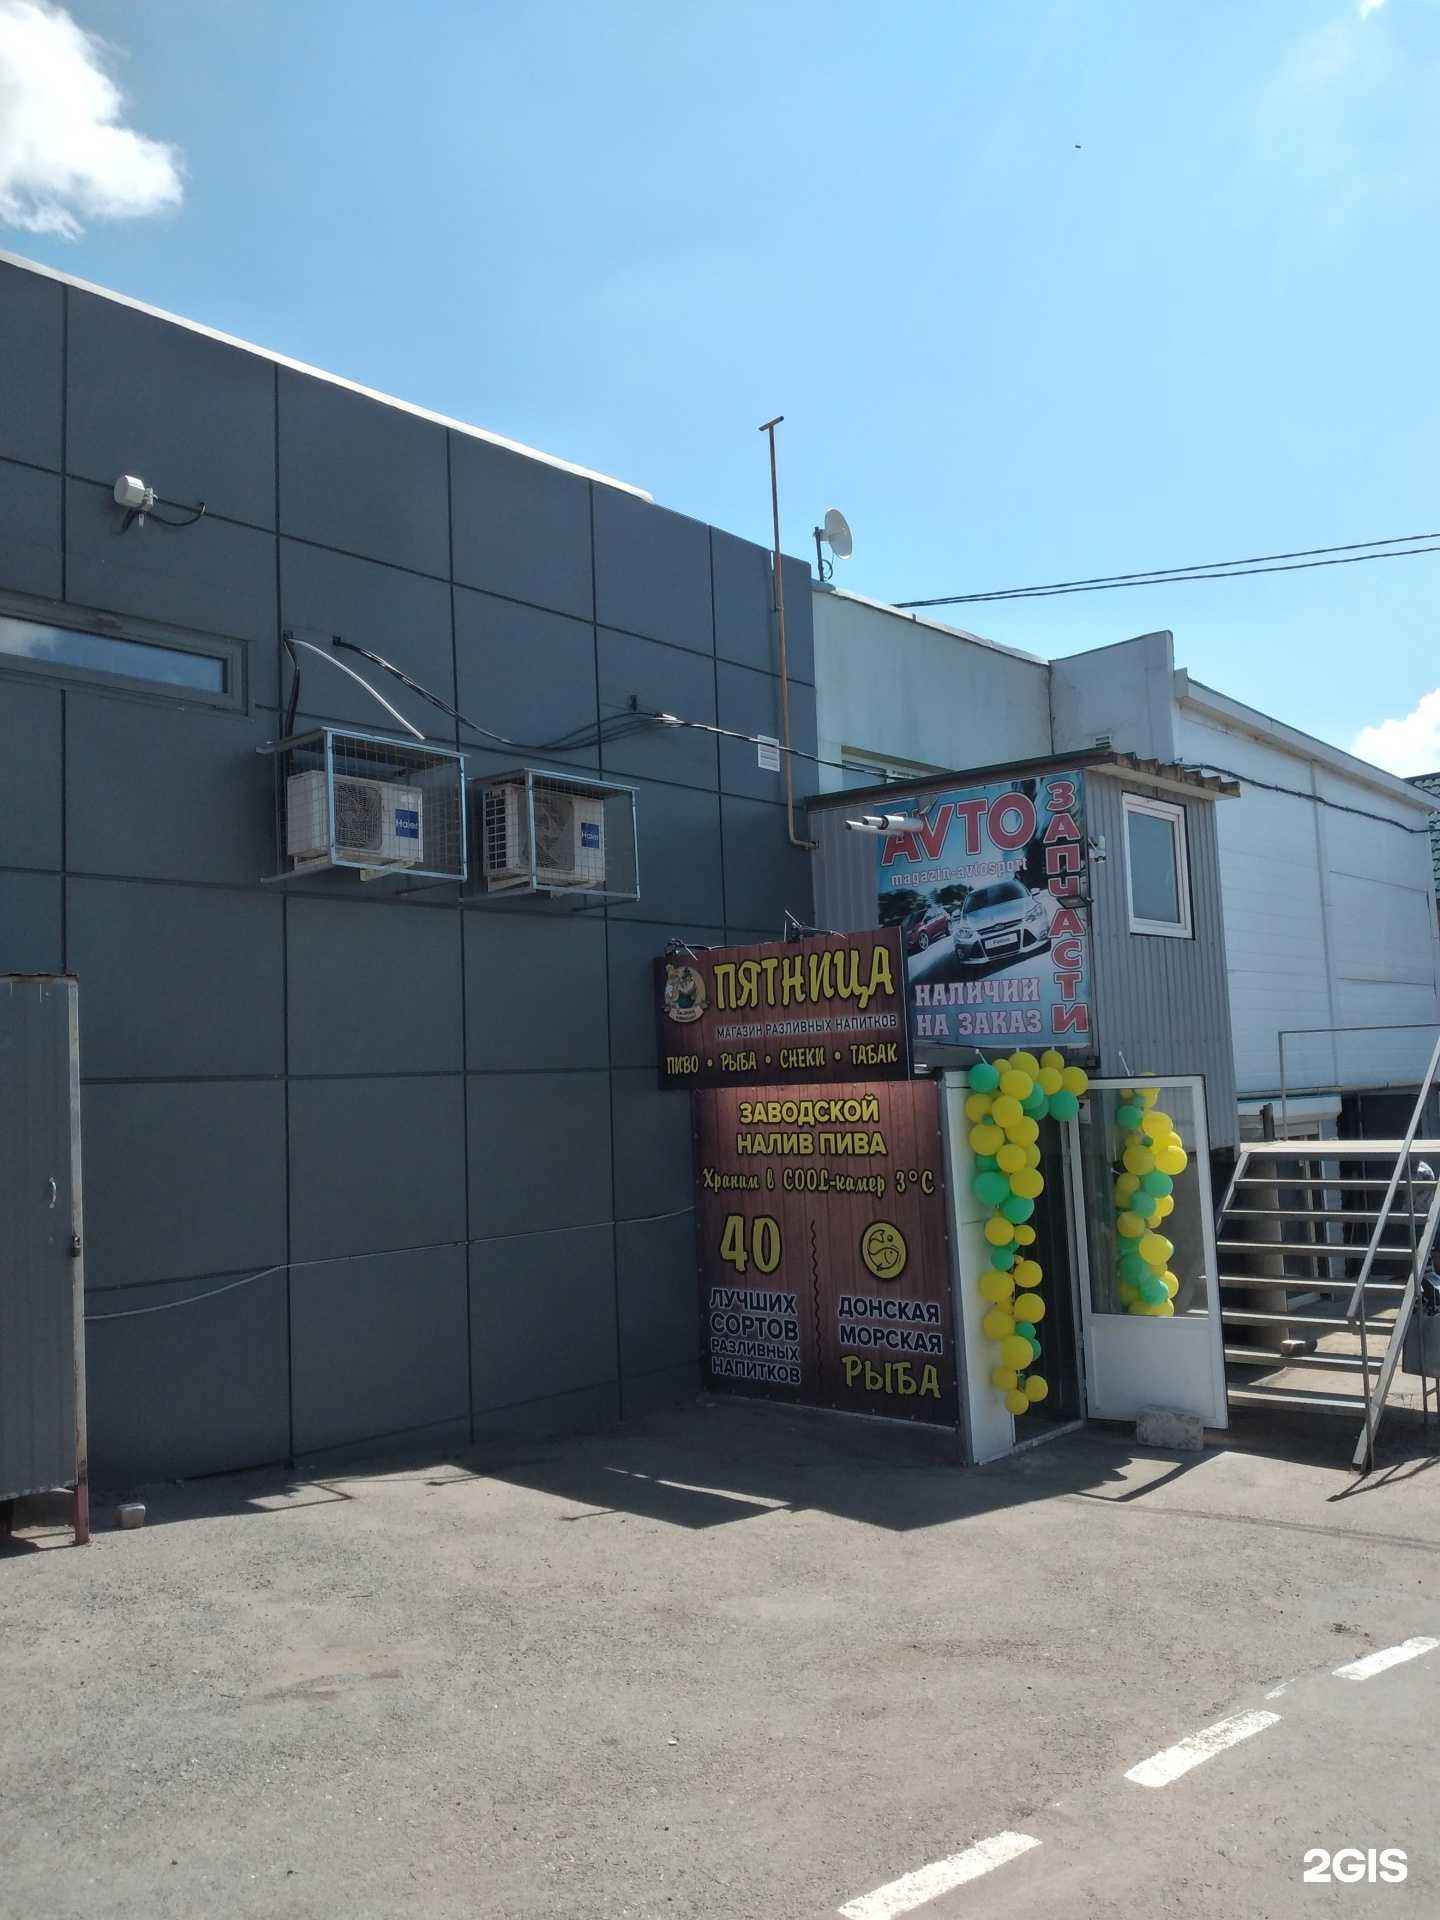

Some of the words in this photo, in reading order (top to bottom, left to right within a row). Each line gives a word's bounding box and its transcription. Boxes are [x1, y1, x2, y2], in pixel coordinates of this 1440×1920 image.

[881, 792, 1037, 867] AVTO
[1043, 780, 1089, 1034] ЗАПЧАСТИ
[713, 945, 895, 1010] ПЯТНИЦА
[915, 978, 1041, 1007] НАЛИЧИИ
[717, 1023, 762, 1040] МАГАЗИН
[766, 1018, 832, 1036] РАЗЛИВНЫХ
[835, 1014, 897, 1031] НАПИТКОВ
[916, 1013, 950, 1037] НА
[958, 1009, 1043, 1036] ЗАКАЗ
[666, 1055, 699, 1075] ПИВО
[720, 1051, 757, 1072] РЫБА
[780, 1047, 826, 1069] СНЕКИ
[849, 1042, 898, 1065] ТАБАК
[739, 1094, 880, 1126] ЗАВОДСКОЙ
[737, 1132, 814, 1155] НАЛИВ
[819, 1132, 888, 1156] ПИВА
[702, 1168, 760, 1192] Храним
[766, 1168, 776, 1190] в
[719, 1215, 782, 1274] 40
[710, 1288, 797, 1314] ЛУЧШИХ
[839, 1296, 941, 1323] ДОНСКАЯ
[711, 1312, 799, 1341] СОРТОВ
[839, 1324, 944, 1355] МОРСКАЯ
[711, 1337, 800, 1362] РАЗЛИВНЫХ
[711, 1357, 801, 1384] НАПИТКОВ
[841, 1355, 942, 1398] РЫБА
